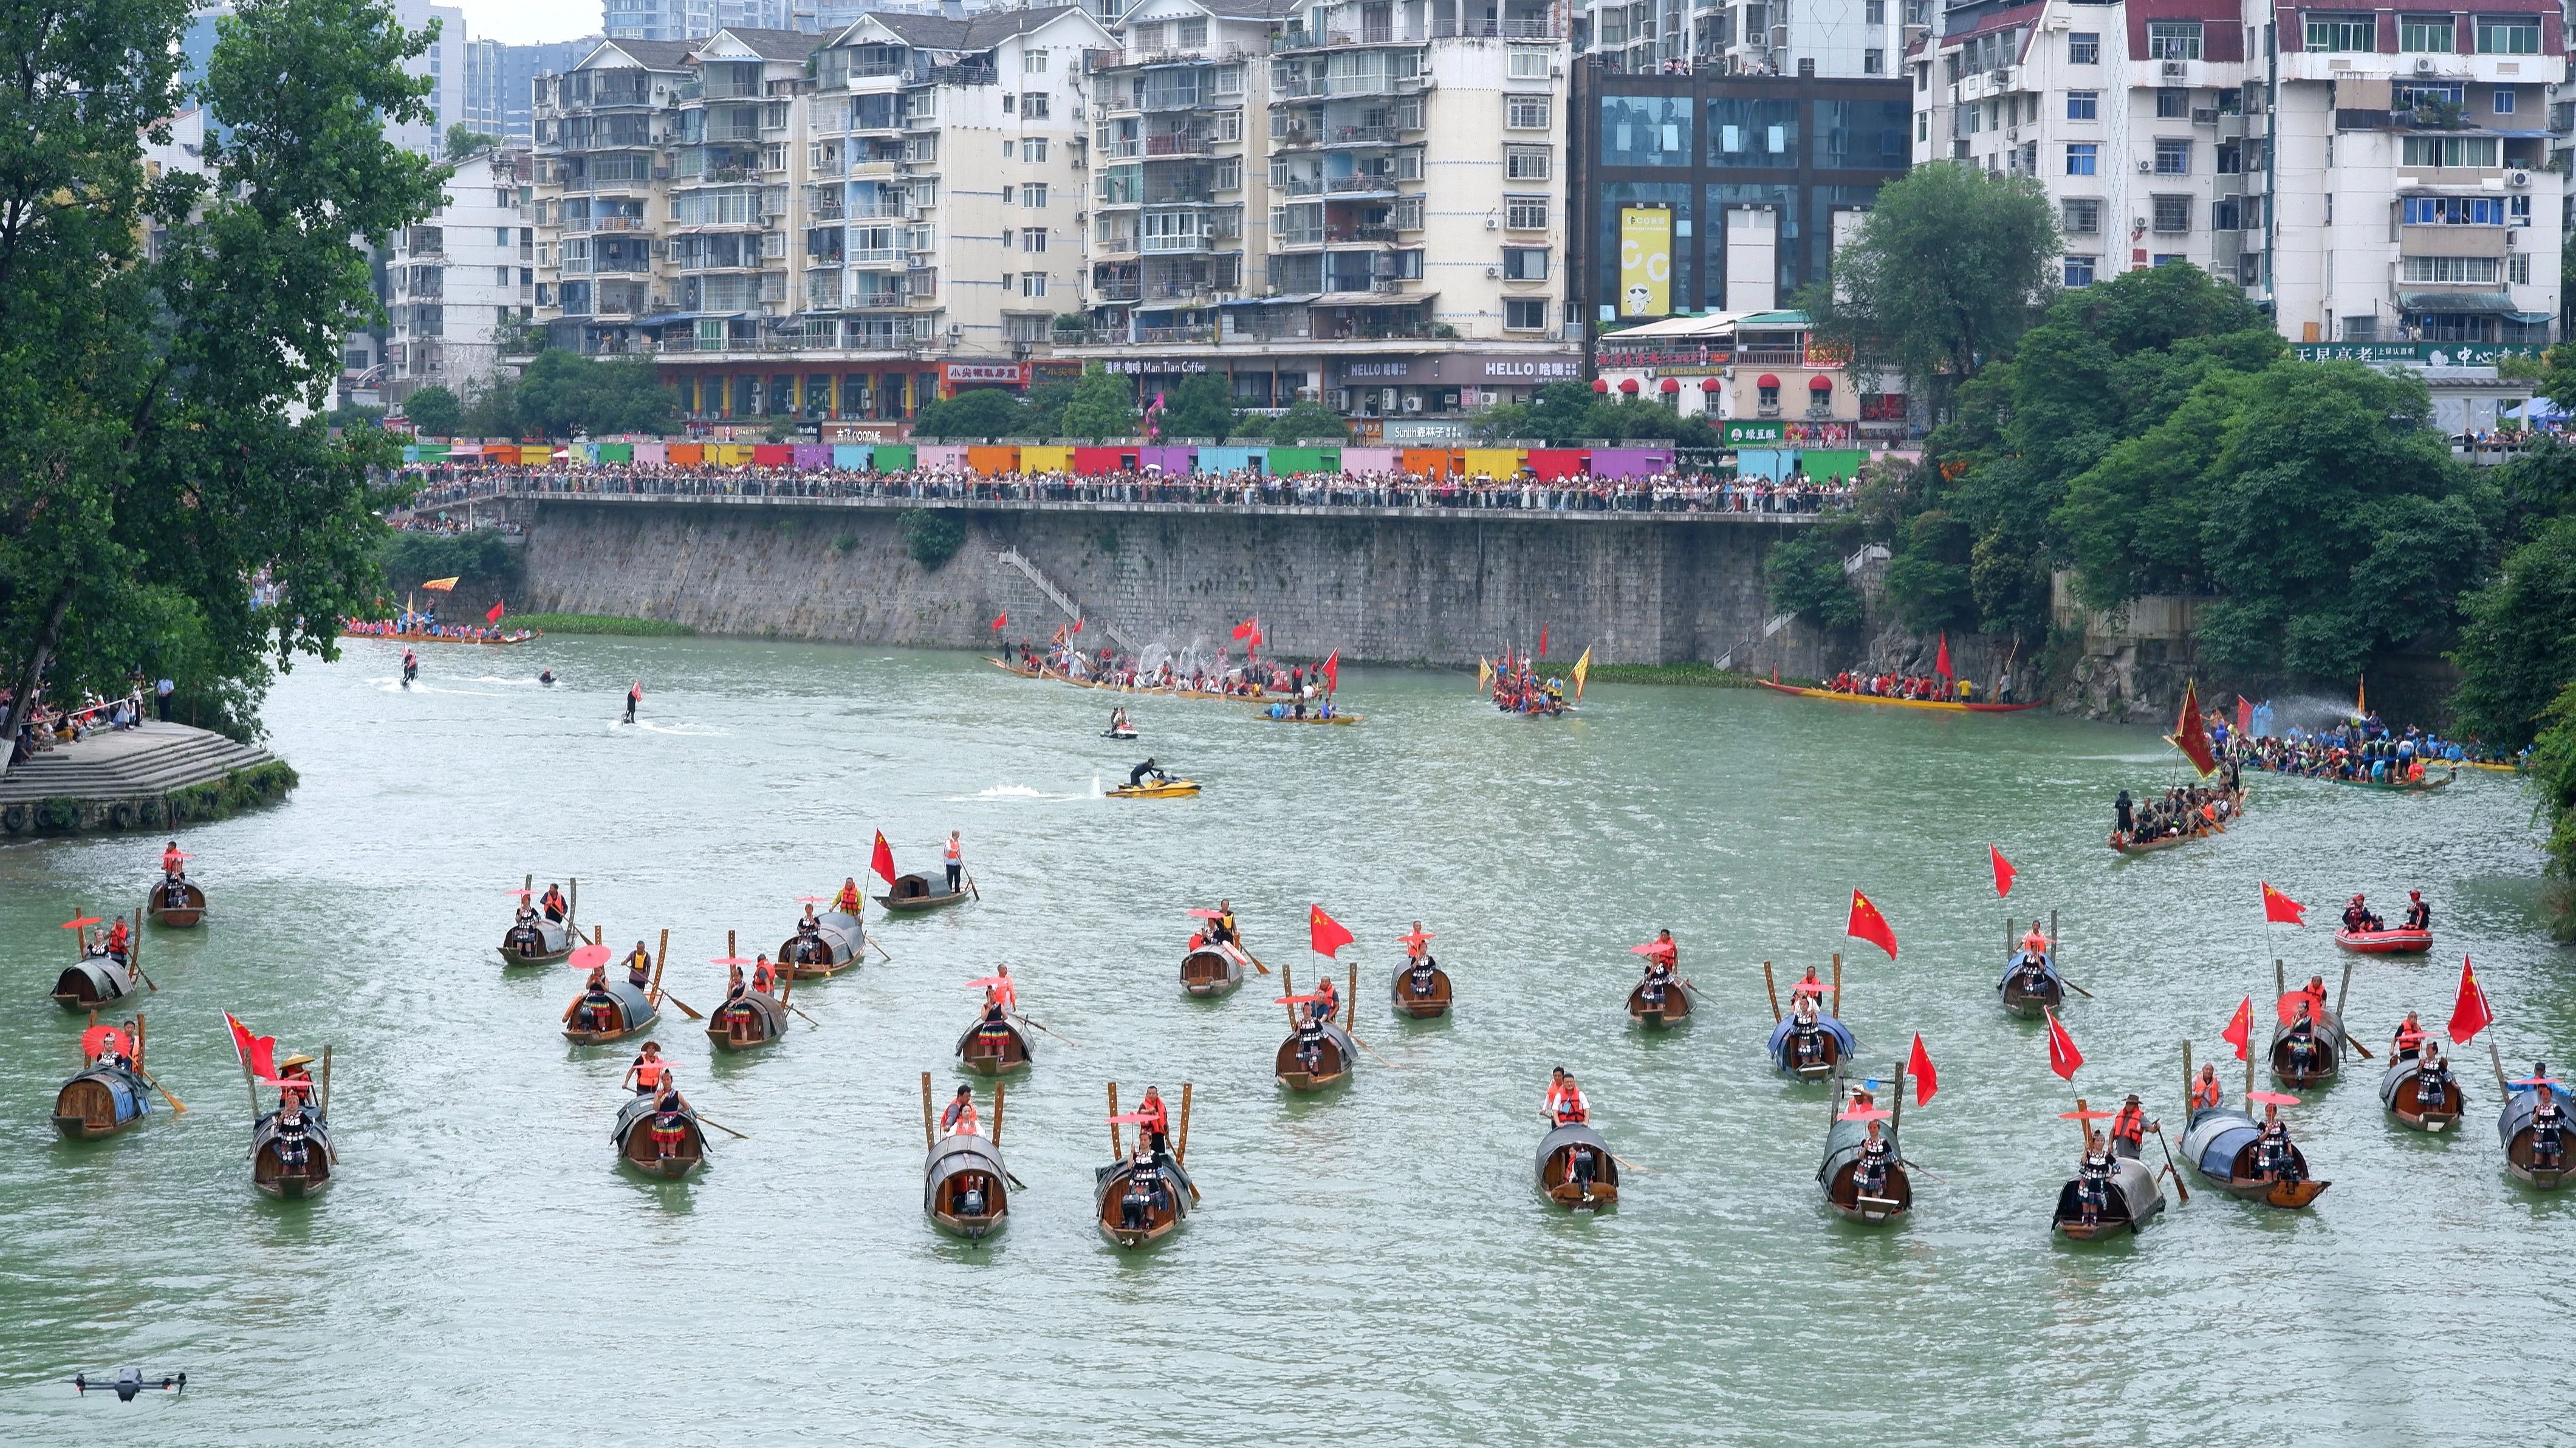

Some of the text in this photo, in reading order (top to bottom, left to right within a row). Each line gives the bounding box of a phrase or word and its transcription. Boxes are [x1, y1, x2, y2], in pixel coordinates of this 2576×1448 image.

[2295, 346, 2415, 364] 天星高考 上课认真听
[950, 367, 1017, 378] 小尖椒私房菜
[1143, 361, 1160, 373] Man
[1163, 361, 1180, 373] Tian
[1182, 361, 1206, 374] Coffee
[1351, 363, 1381, 376] HELLO
[1485, 362, 1534, 376] HELLO
[1539, 362, 1564, 376] 哈喽
[804, 426, 817, 434] coffee
[1417, 426, 1444, 438] 森林子
[1745, 429, 1776, 440] 绿豆酥
